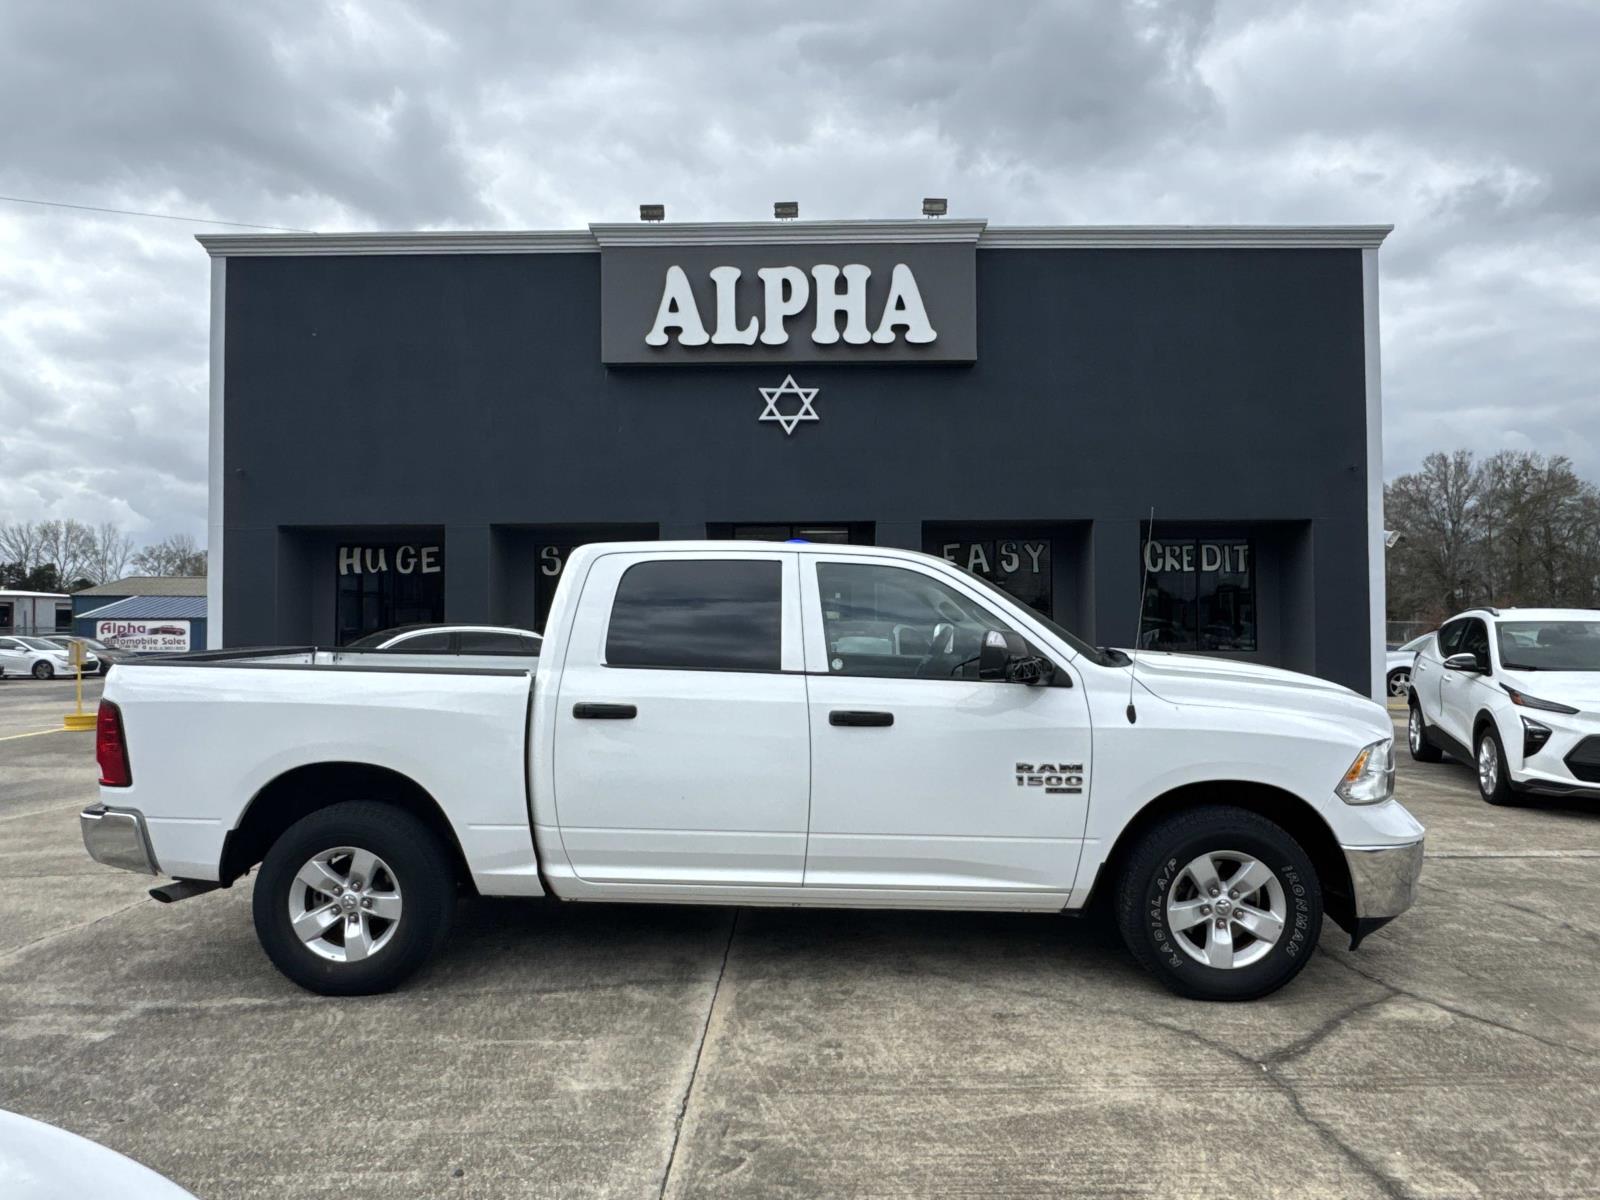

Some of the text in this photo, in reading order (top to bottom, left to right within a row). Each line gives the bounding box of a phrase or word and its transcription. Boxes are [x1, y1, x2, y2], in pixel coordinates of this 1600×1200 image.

[645, 263, 937, 346] ALPHA
[339, 546, 441, 575] HUGE
[943, 543, 1044, 573] EASY
[1143, 541, 1249, 572] CREDIT
[100, 622, 147, 635] Alpha
[162, 637, 186, 646] Sales
[1016, 763, 1083, 774] RAM
[1016, 775, 1083, 786] 1500
[1281, 865, 1309, 958] IRONMAN
[1151, 895, 1183, 969] RADIAL
